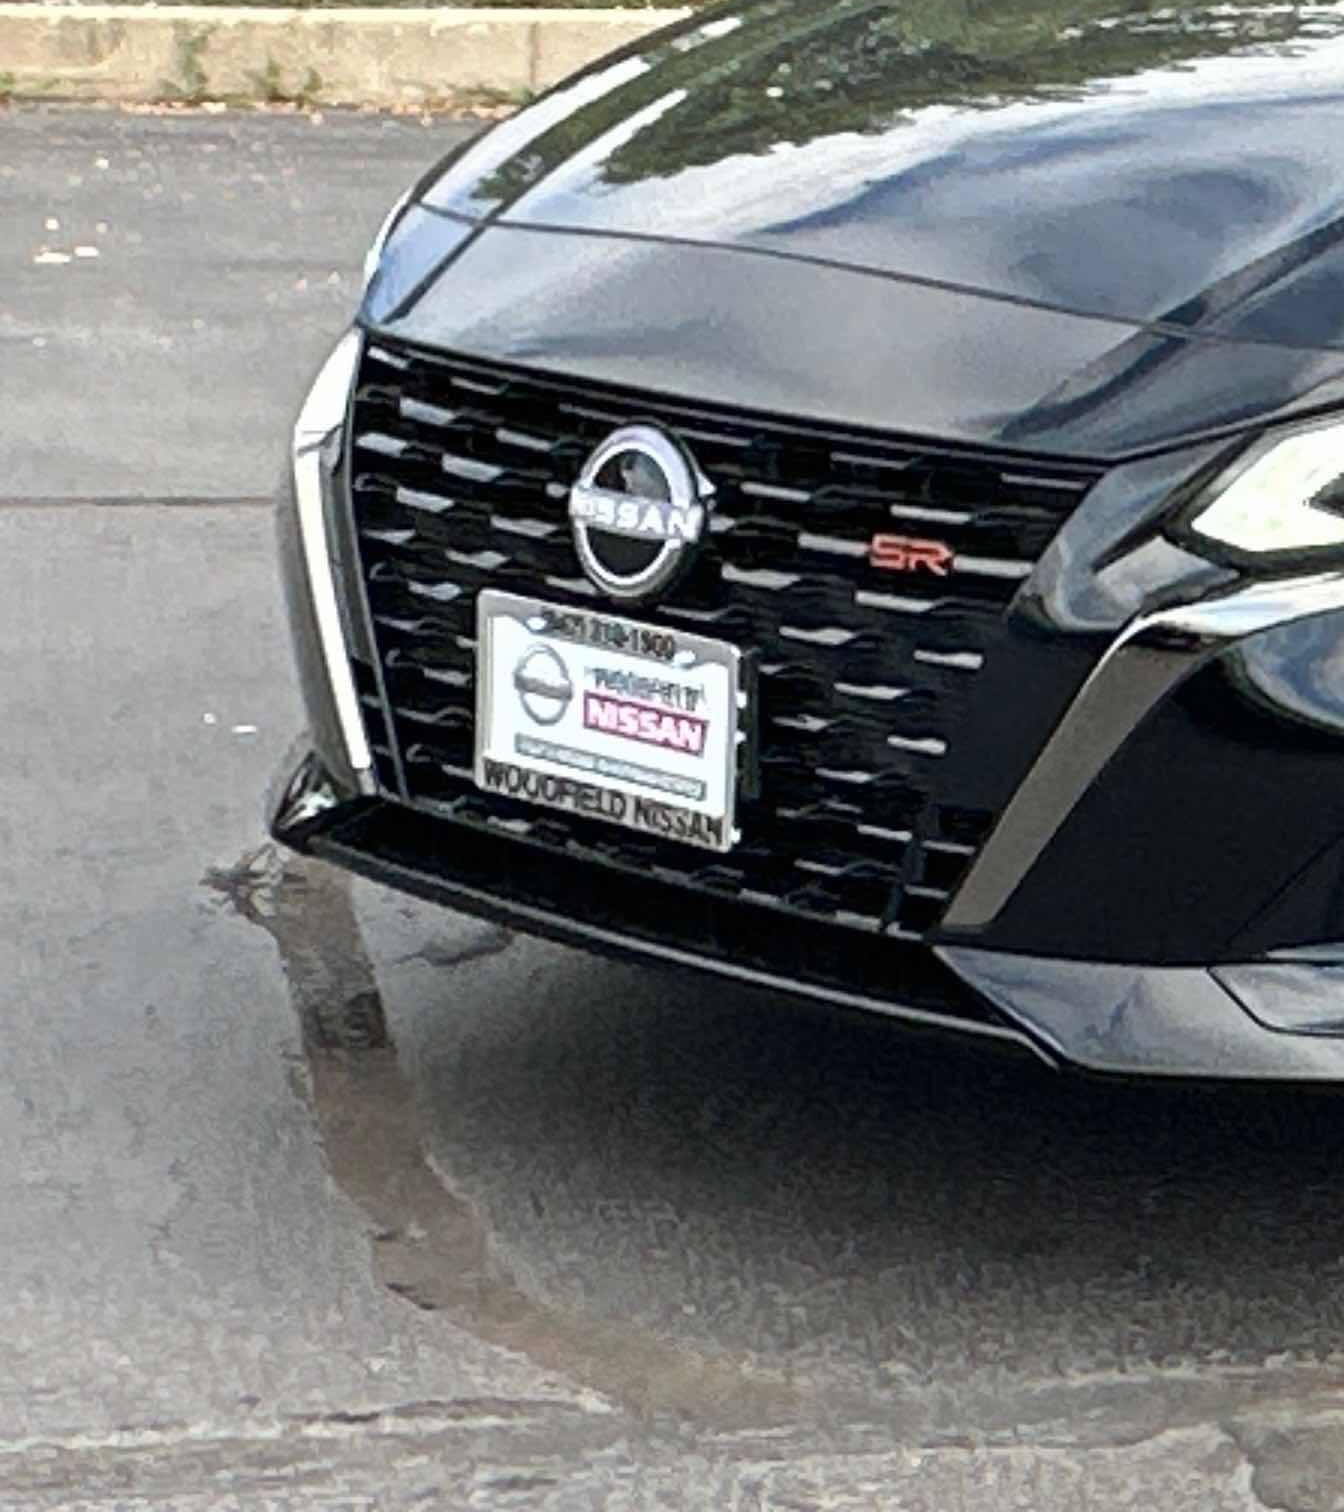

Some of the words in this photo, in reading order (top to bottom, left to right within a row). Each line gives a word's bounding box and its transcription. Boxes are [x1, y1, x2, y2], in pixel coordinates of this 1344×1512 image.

[570, 490, 703, 542] NISSAN
[869, 533, 953, 577] SR
[588, 696, 703, 753] NISSAN
[634, 793, 723, 847] NISSAN
